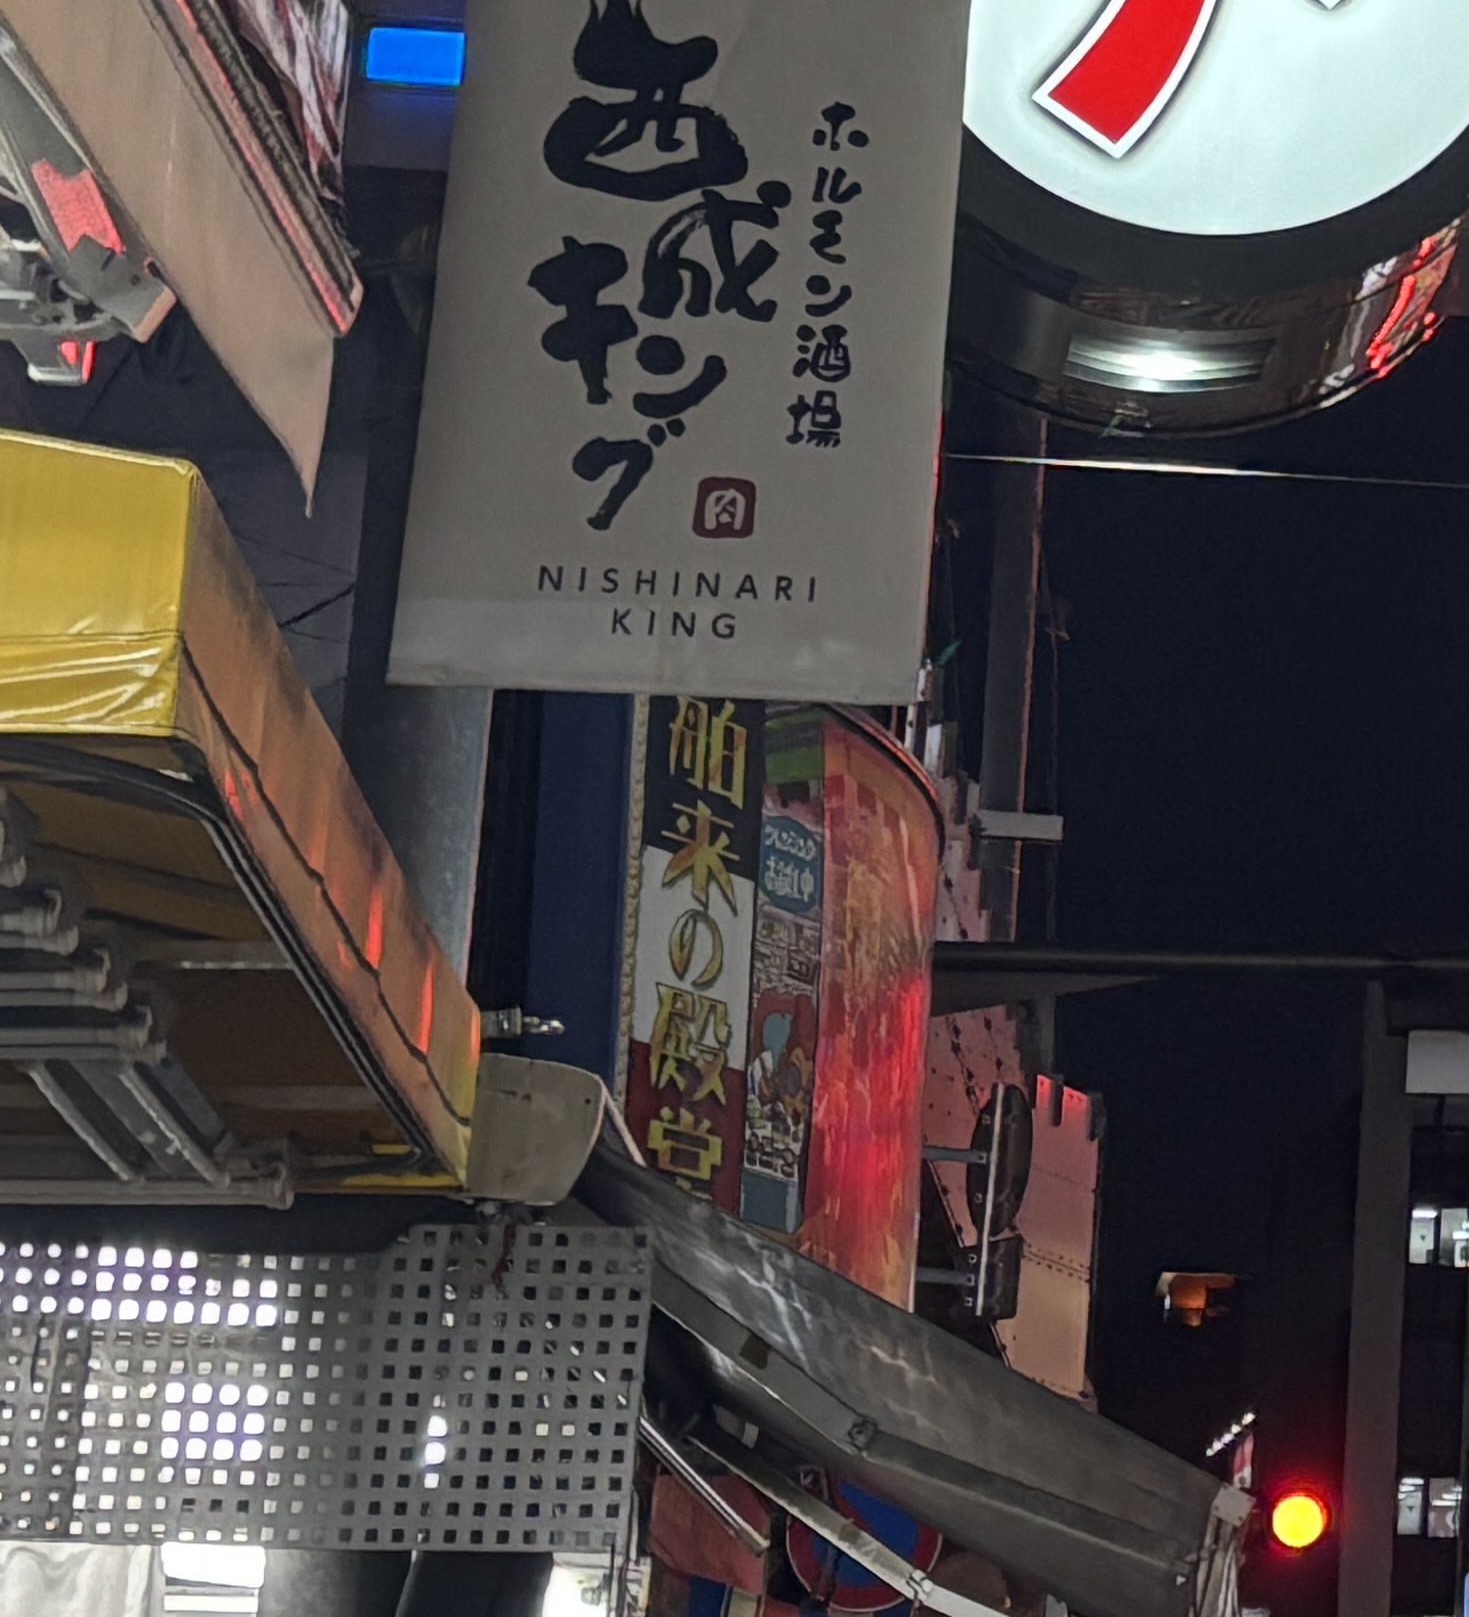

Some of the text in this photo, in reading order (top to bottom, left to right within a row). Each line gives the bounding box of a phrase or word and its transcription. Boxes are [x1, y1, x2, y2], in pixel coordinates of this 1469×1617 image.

[785, 100, 870, 449] ホルモン酒場
[537, 565, 818, 604] NISHINARI
[610, 609, 738, 641] KING
